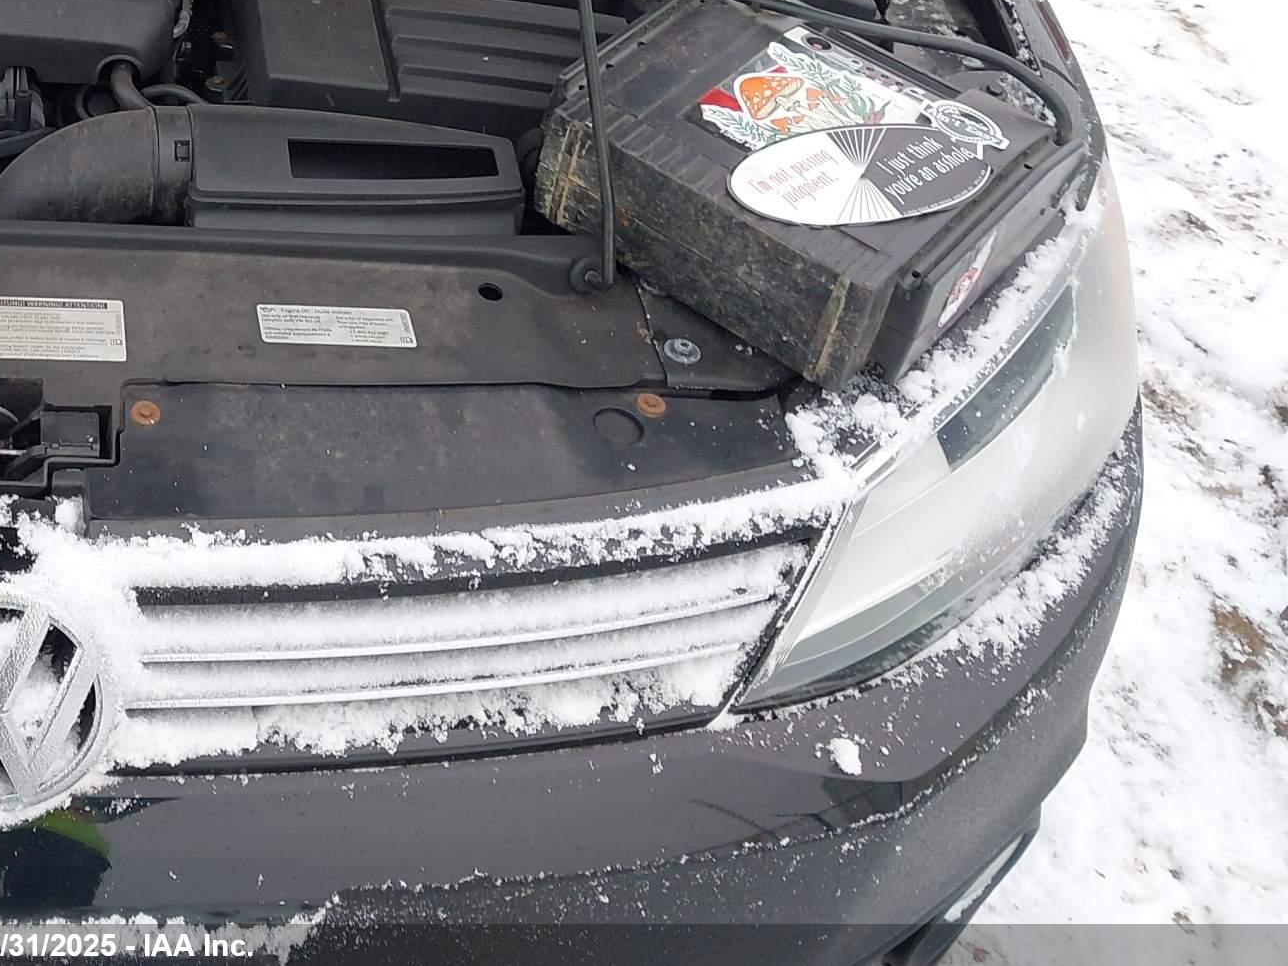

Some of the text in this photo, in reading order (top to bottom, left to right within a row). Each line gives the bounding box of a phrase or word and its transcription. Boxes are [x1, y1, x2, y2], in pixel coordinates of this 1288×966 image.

[883, 151, 916, 177] just
[905, 135, 944, 160] think
[884, 174, 924, 206] you're
[917, 166, 939, 182] an
[932, 145, 975, 174] asshole
